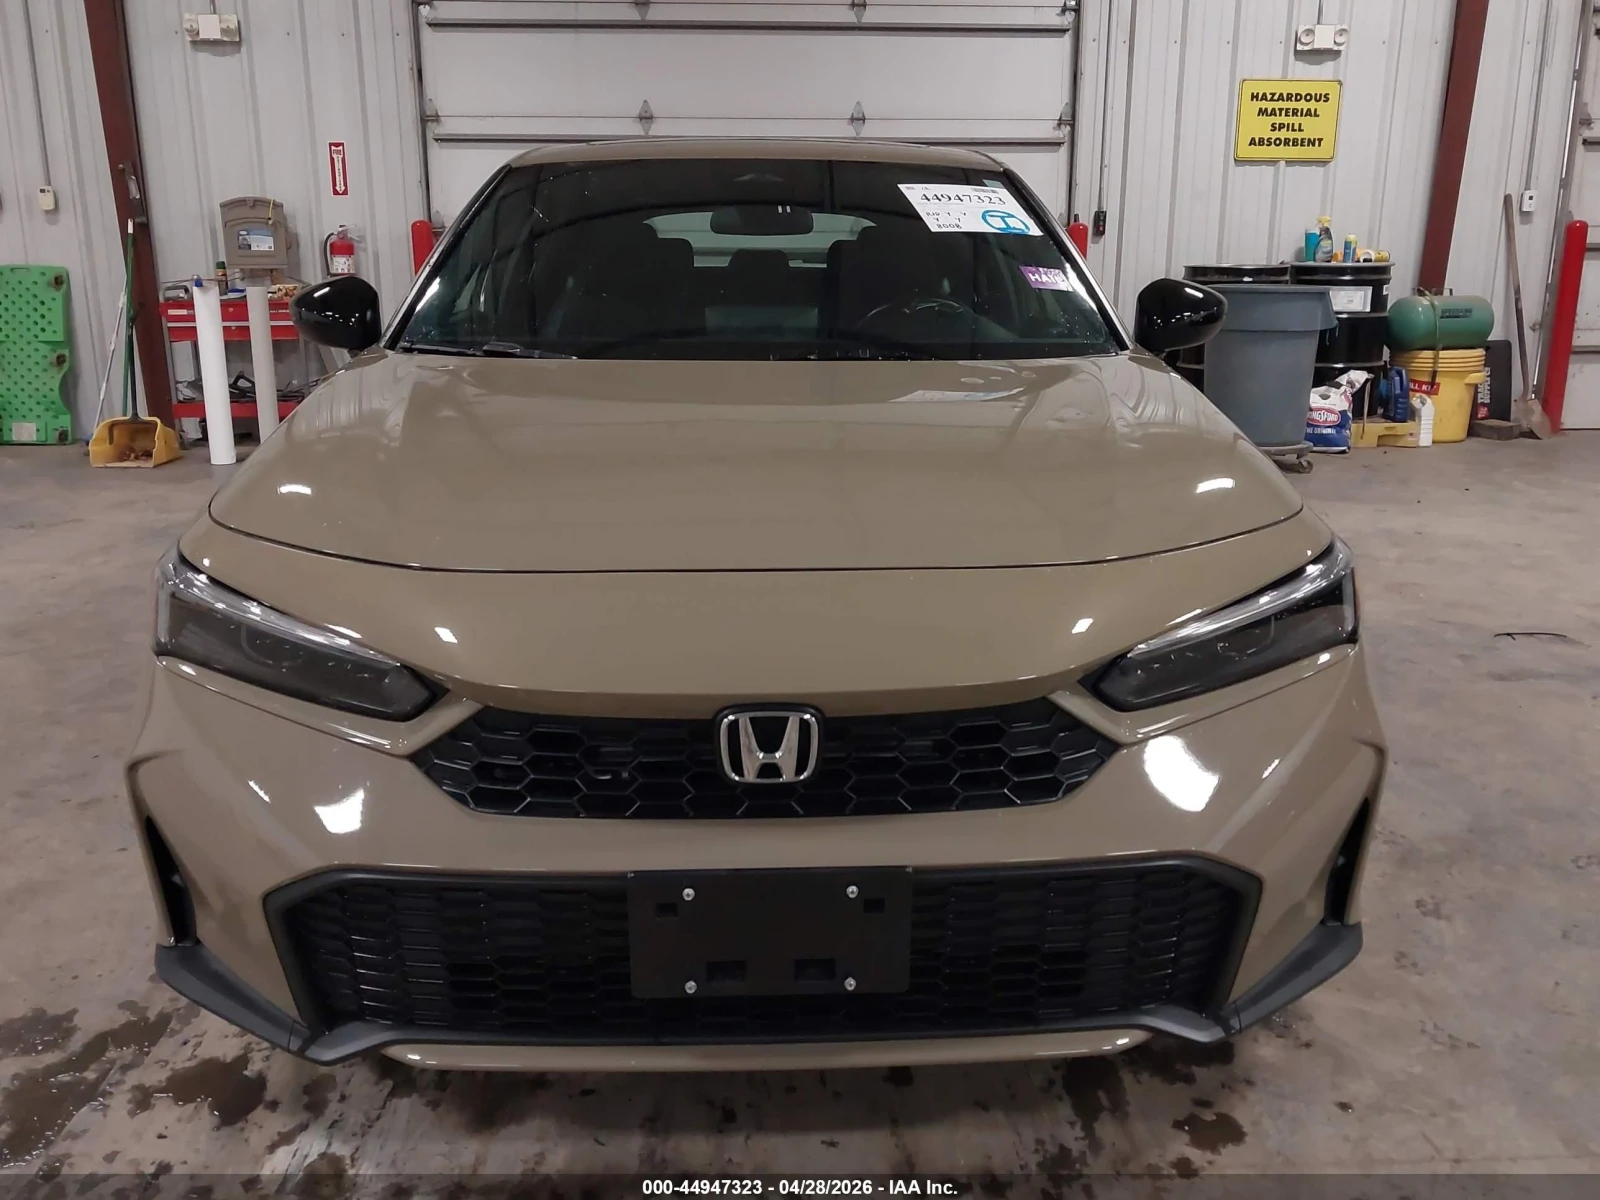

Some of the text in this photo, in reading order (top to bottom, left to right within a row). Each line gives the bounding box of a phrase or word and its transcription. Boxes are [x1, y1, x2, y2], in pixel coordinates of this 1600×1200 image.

[1250, 92, 1330, 103] HAZARDOUS
[1257, 107, 1320, 117] MATERIAL
[1270, 122, 1304, 132] SPILL
[1248, 137, 1324, 147] ABSORBENT
[920, 193, 1006, 206] 44947323
